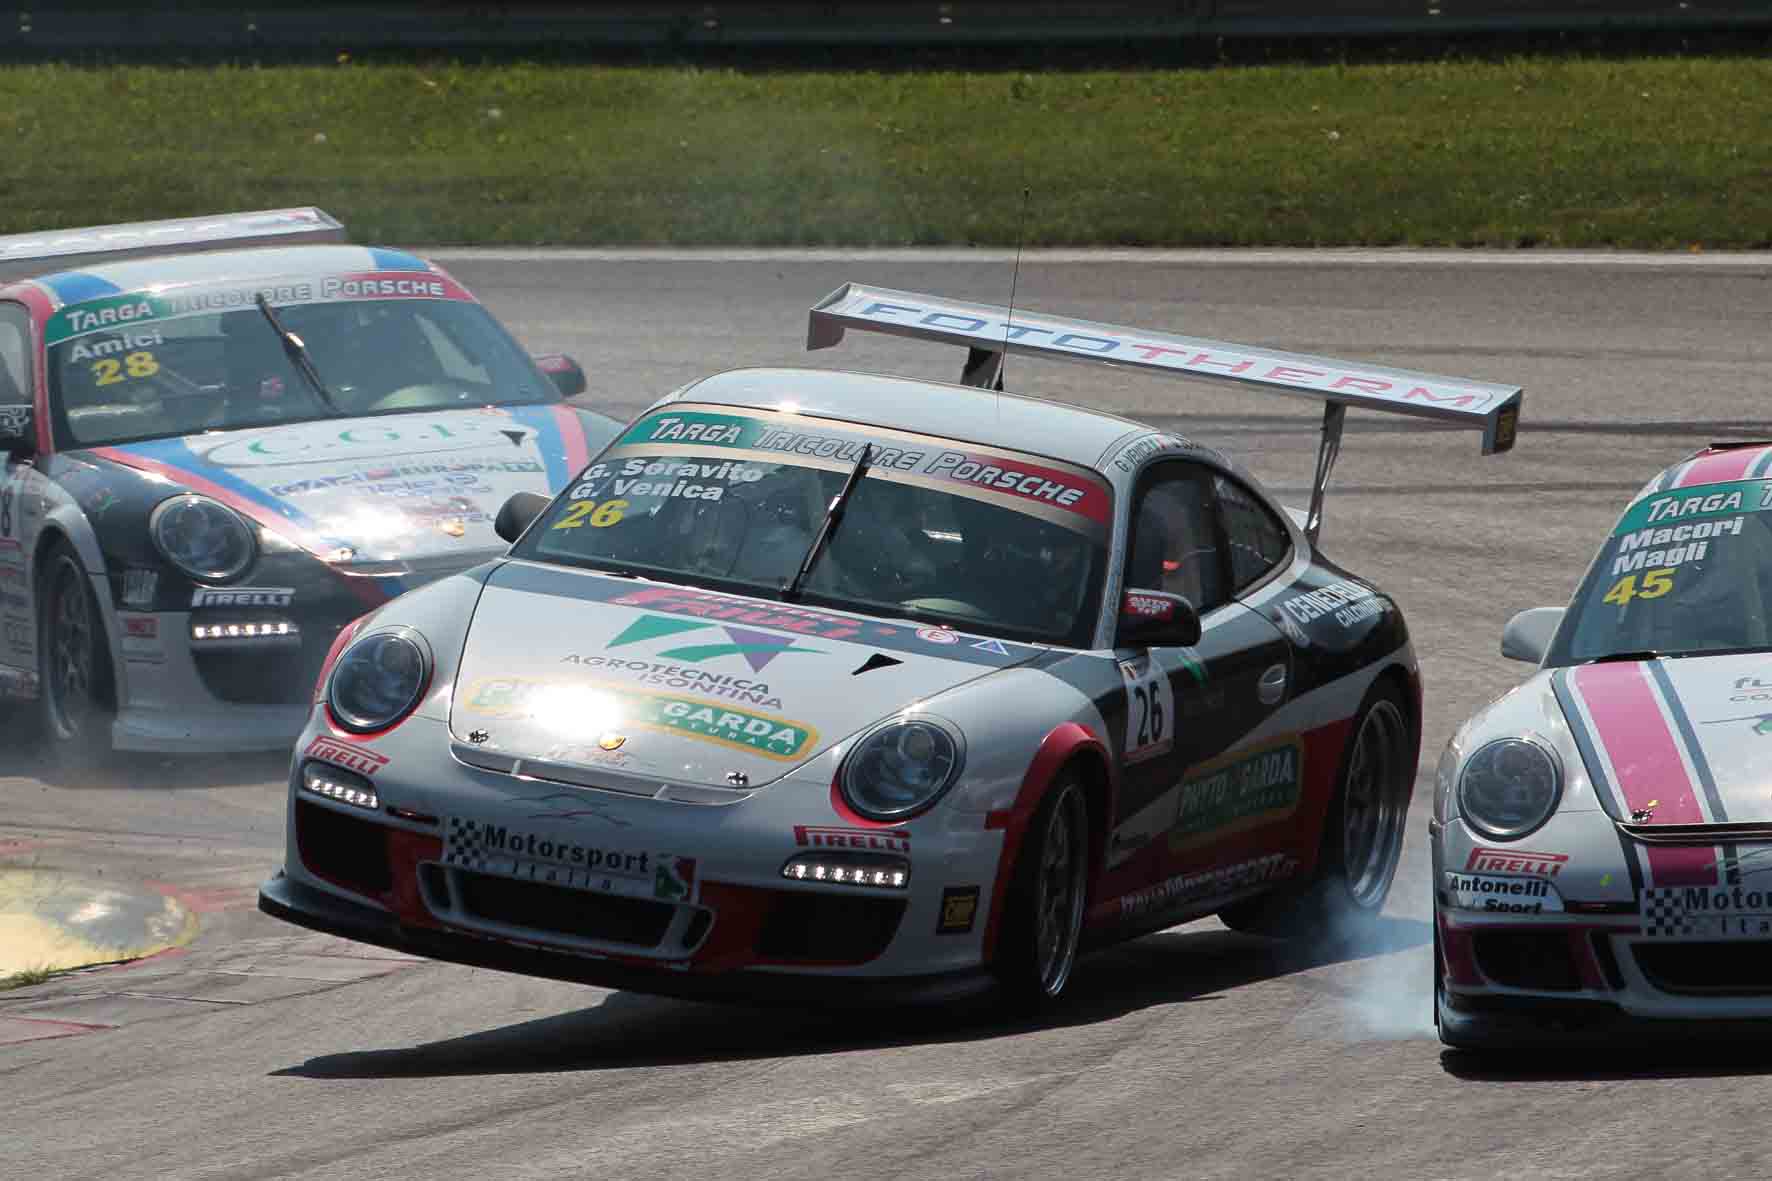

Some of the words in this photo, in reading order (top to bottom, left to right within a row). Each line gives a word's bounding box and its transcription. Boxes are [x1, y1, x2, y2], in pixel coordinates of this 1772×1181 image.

[66, 301, 153, 333] TARGA
[320, 277, 444, 299] PORSCHE
[71, 330, 163, 363] Amici
[862, 302, 1474, 408] FOTOTHERM
[90, 351, 160, 388] 28
[583, 463, 612, 482] G.
[621, 459, 764, 485] Soravito
[649, 417, 742, 444] TARGA
[752, 424, 926, 472] TRICOLORE
[926, 451, 1087, 506] PORSCHE
[568, 482, 600, 501] G.
[613, 479, 724, 501] Venica
[1647, 491, 1743, 523] TARGA
[552, 499, 630, 530] 26
[1619, 516, 1745, 553] Macori
[1611, 541, 1709, 576] Magli
[192, 587, 297, 607] PIRELLI
[1602, 567, 1681, 606] 45
[637, 672, 784, 710] ISONTINA
[663, 702, 797, 746] GARDA
[1134, 680, 1163, 746] 26
[306, 735, 391, 775] PIRELLI
[482, 822, 650, 874] Motorsport
[793, 826, 912, 851] PIRELLI
[1465, 847, 1569, 876] PIRELLI
[1450, 876, 1550, 898] Antonelli
[1483, 896, 1542, 914] Sport
